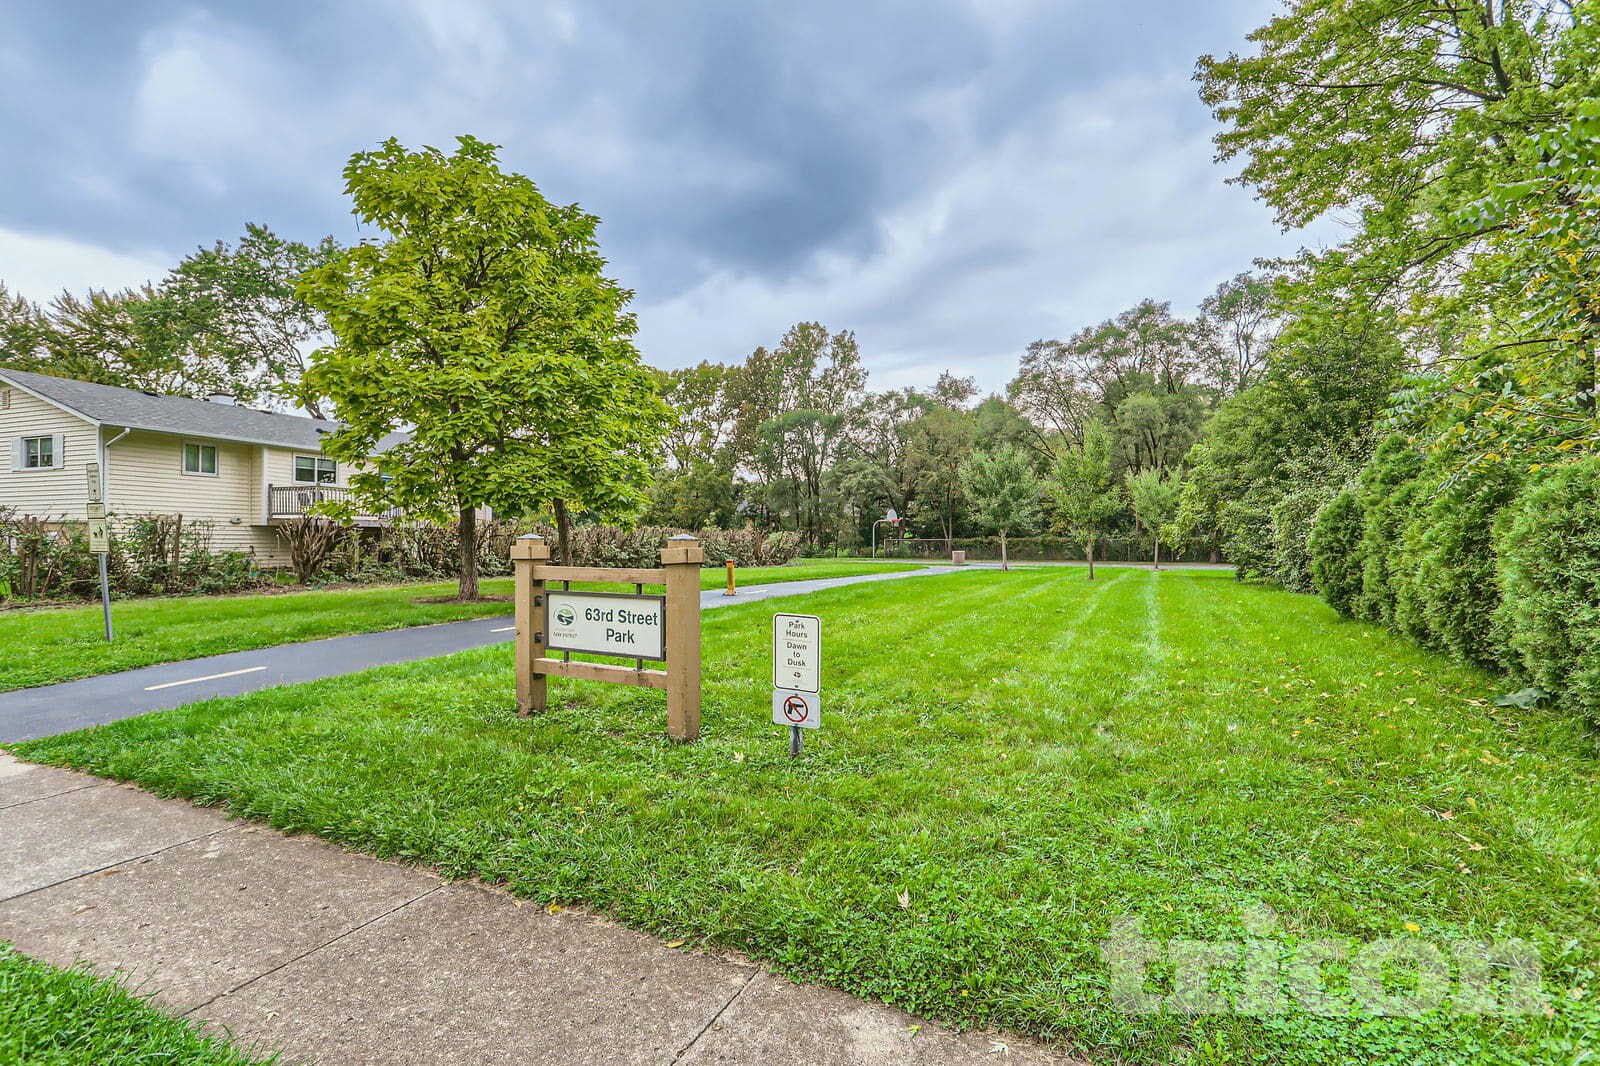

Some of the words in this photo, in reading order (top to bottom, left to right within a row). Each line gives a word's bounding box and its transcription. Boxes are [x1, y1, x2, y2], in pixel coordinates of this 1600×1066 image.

[585, 608, 613, 622] 63rd
[618, 610, 658, 626] Street
[788, 621, 805, 630] Park
[606, 628, 635, 644] Park
[785, 630, 808, 639] Hours
[786, 642, 807, 651] Dawn
[787, 658, 806, 667] Dusk
